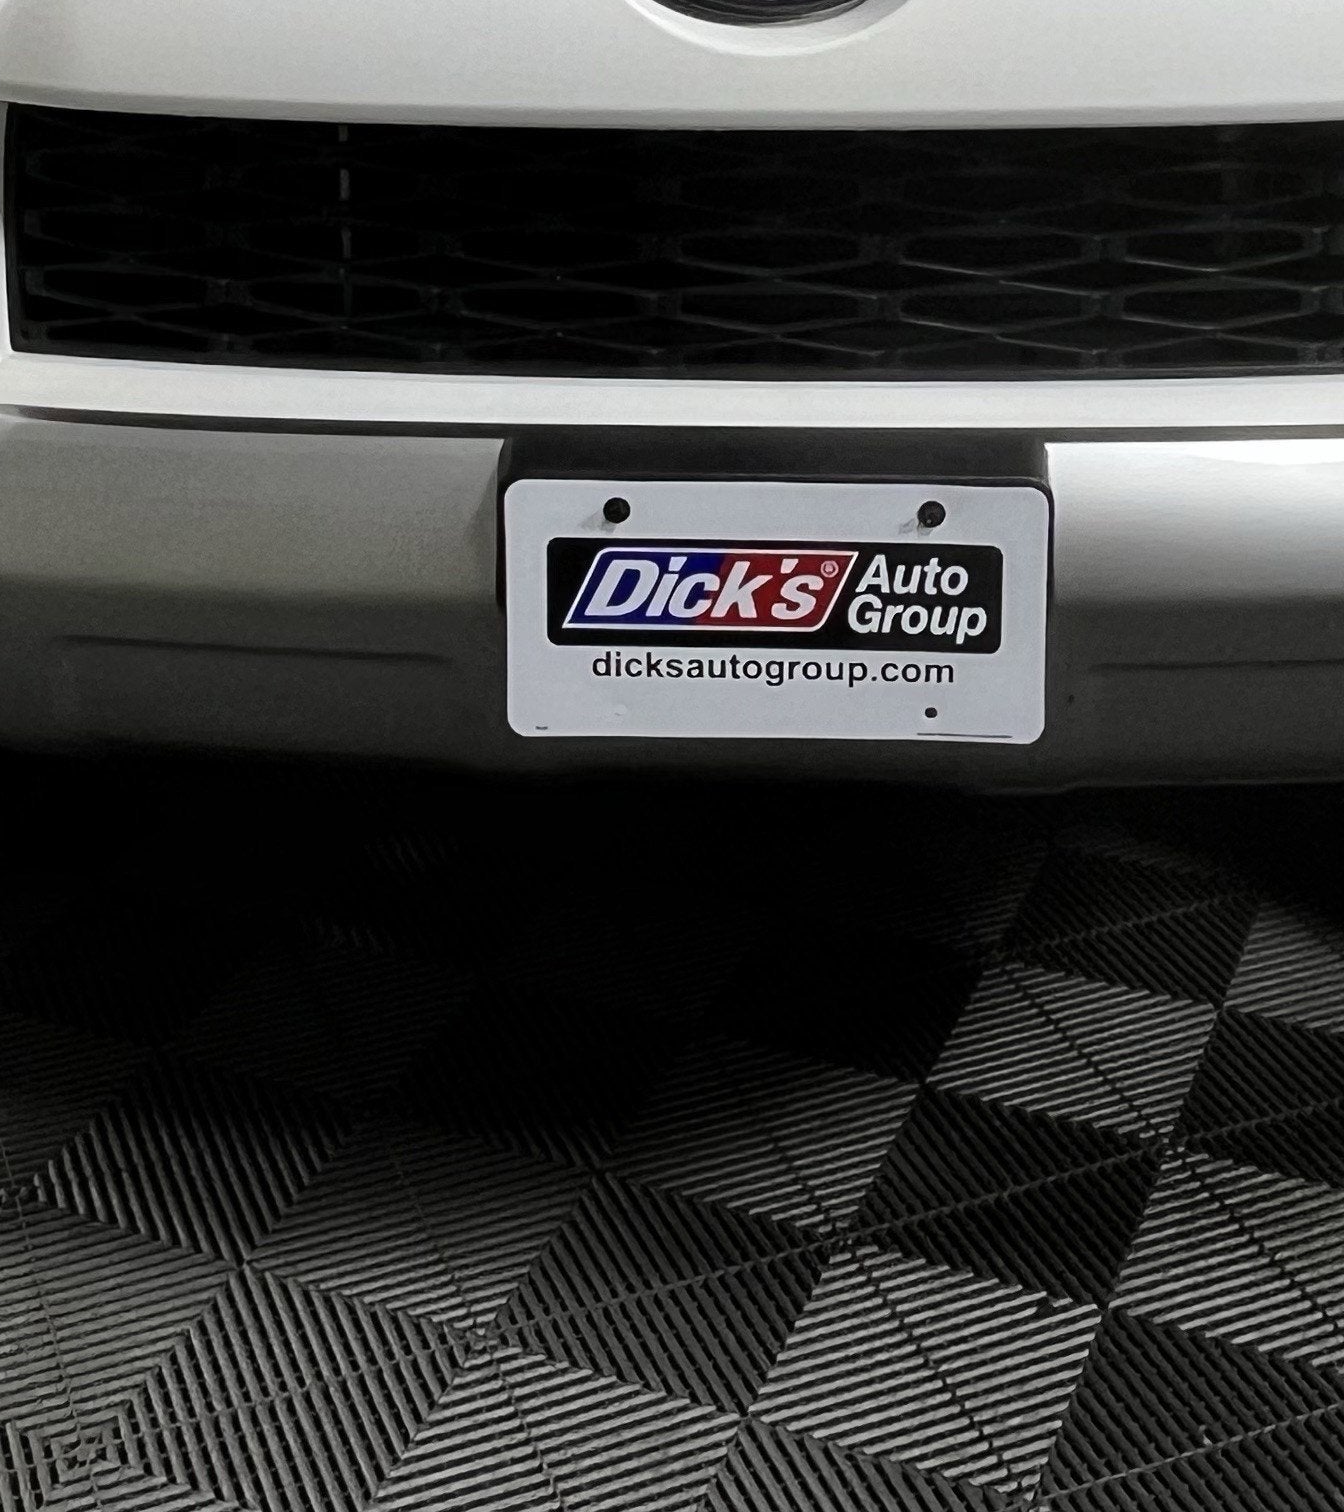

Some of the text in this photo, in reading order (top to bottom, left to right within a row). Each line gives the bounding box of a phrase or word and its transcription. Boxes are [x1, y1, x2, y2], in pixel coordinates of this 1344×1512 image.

[855, 554, 969, 596] Auto
[847, 593, 988, 645] Group
[591, 650, 955, 687] dicksautogroup.com
